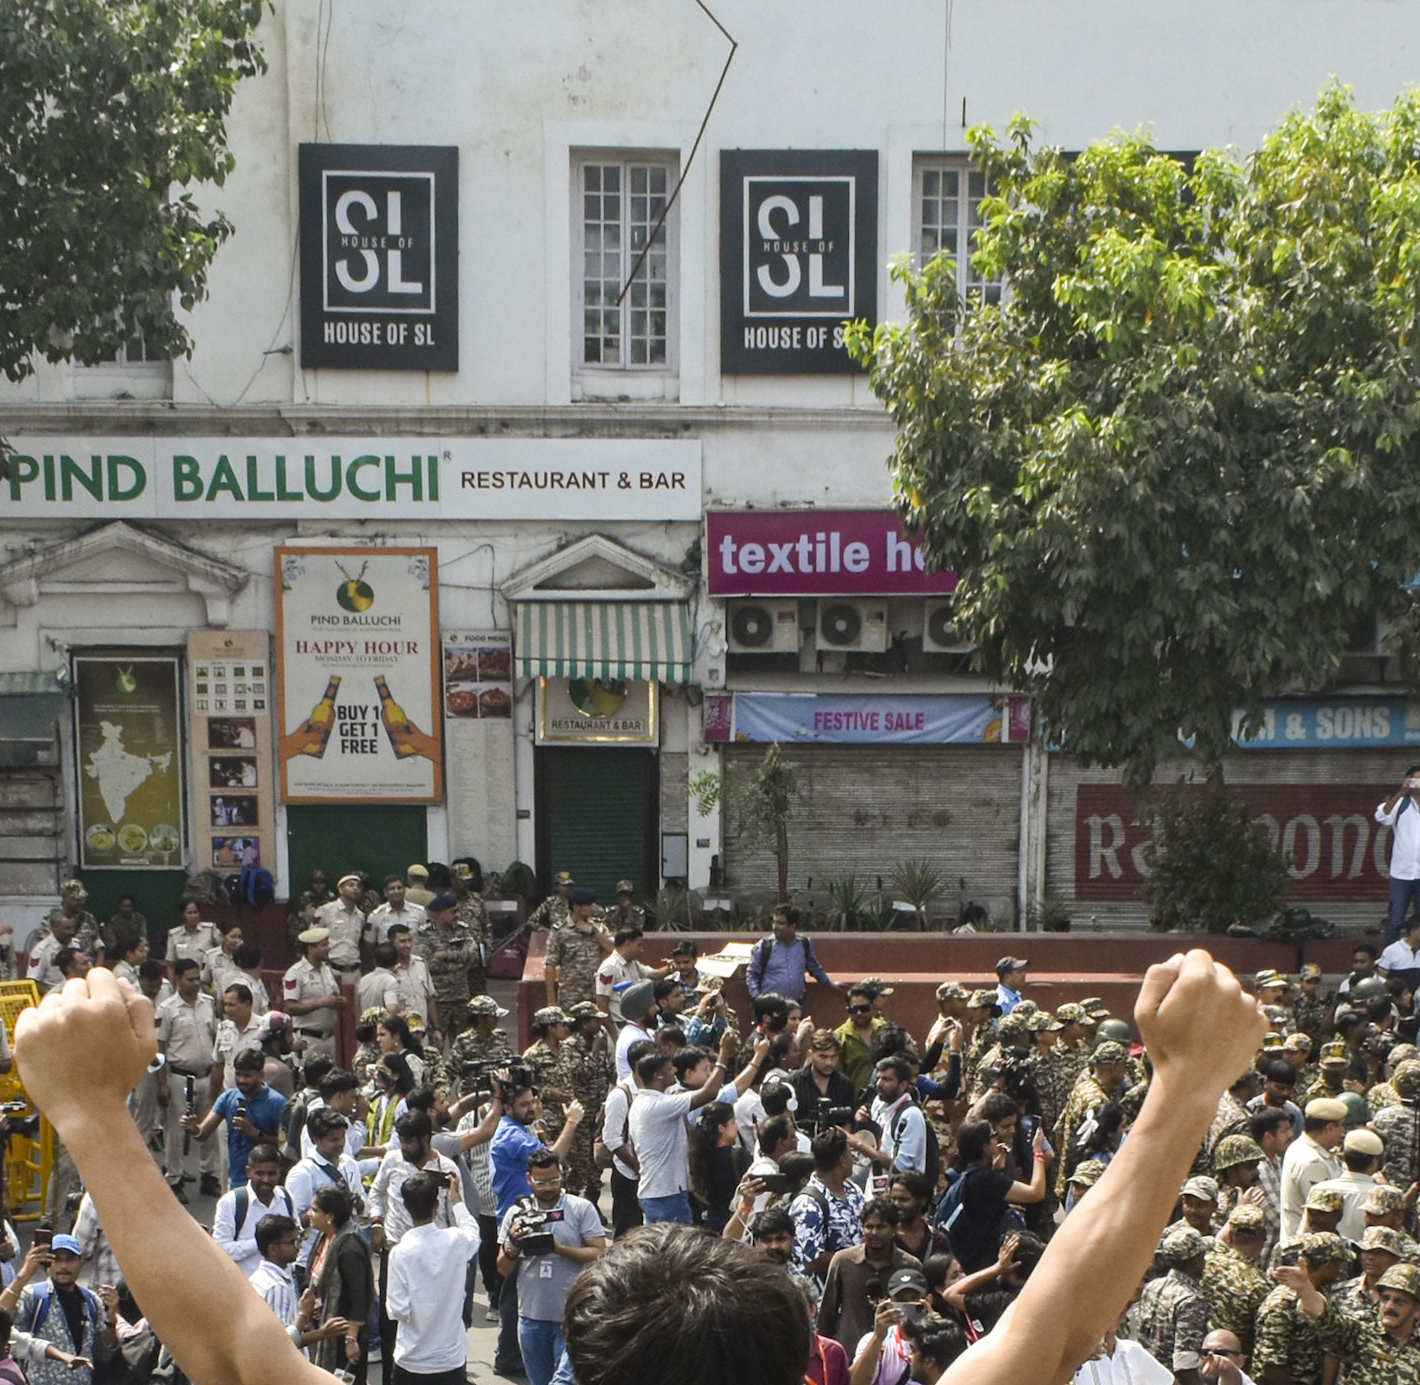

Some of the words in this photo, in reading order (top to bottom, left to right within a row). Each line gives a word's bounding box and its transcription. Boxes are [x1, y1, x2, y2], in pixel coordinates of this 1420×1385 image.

[341, 236, 387, 248] HOUSE
[398, 237, 414, 248] OF
[763, 241, 808, 253] HOUSE
[818, 241, 835, 252] OF
[324, 322, 381, 344] HOUSE
[387, 323, 408, 345] OF
[414, 324, 435, 345] SL
[744, 327, 801, 349] HOUSE
[807, 327, 828, 349] OF
[833, 328, 850, 349] S
[10, 455, 147, 501] PIND
[173, 454, 440, 502] BALLUCHI
[461, 471, 610, 490] RESTAURANT
[617, 472, 633, 490] &
[639, 471, 686, 489] BAR
[720, 532, 870, 574] textile
[310, 615, 340, 626] PIND
[343, 616, 401, 626] BALLUCHI
[296, 641, 357, 655] HAPPY
[364, 641, 418, 654] HOUR
[315, 655, 353, 663] MONDAY
[368, 655, 399, 663] FRIDAY
[338, 706, 369, 721] BUY
[373, 706, 379, 720] 1
[814, 711, 879, 731] FESTIVE
[885, 712, 924, 731] SALE
[339, 722, 368, 737] GET
[372, 723, 378, 737] 1
[552, 720, 610, 730] RESTAURANT
[613, 721, 619, 730] &
[621, 721, 641, 730] BAR
[1286, 713, 1306, 739] &
[1316, 708, 1391, 739] SONS
[341, 739, 378, 754] FREE
